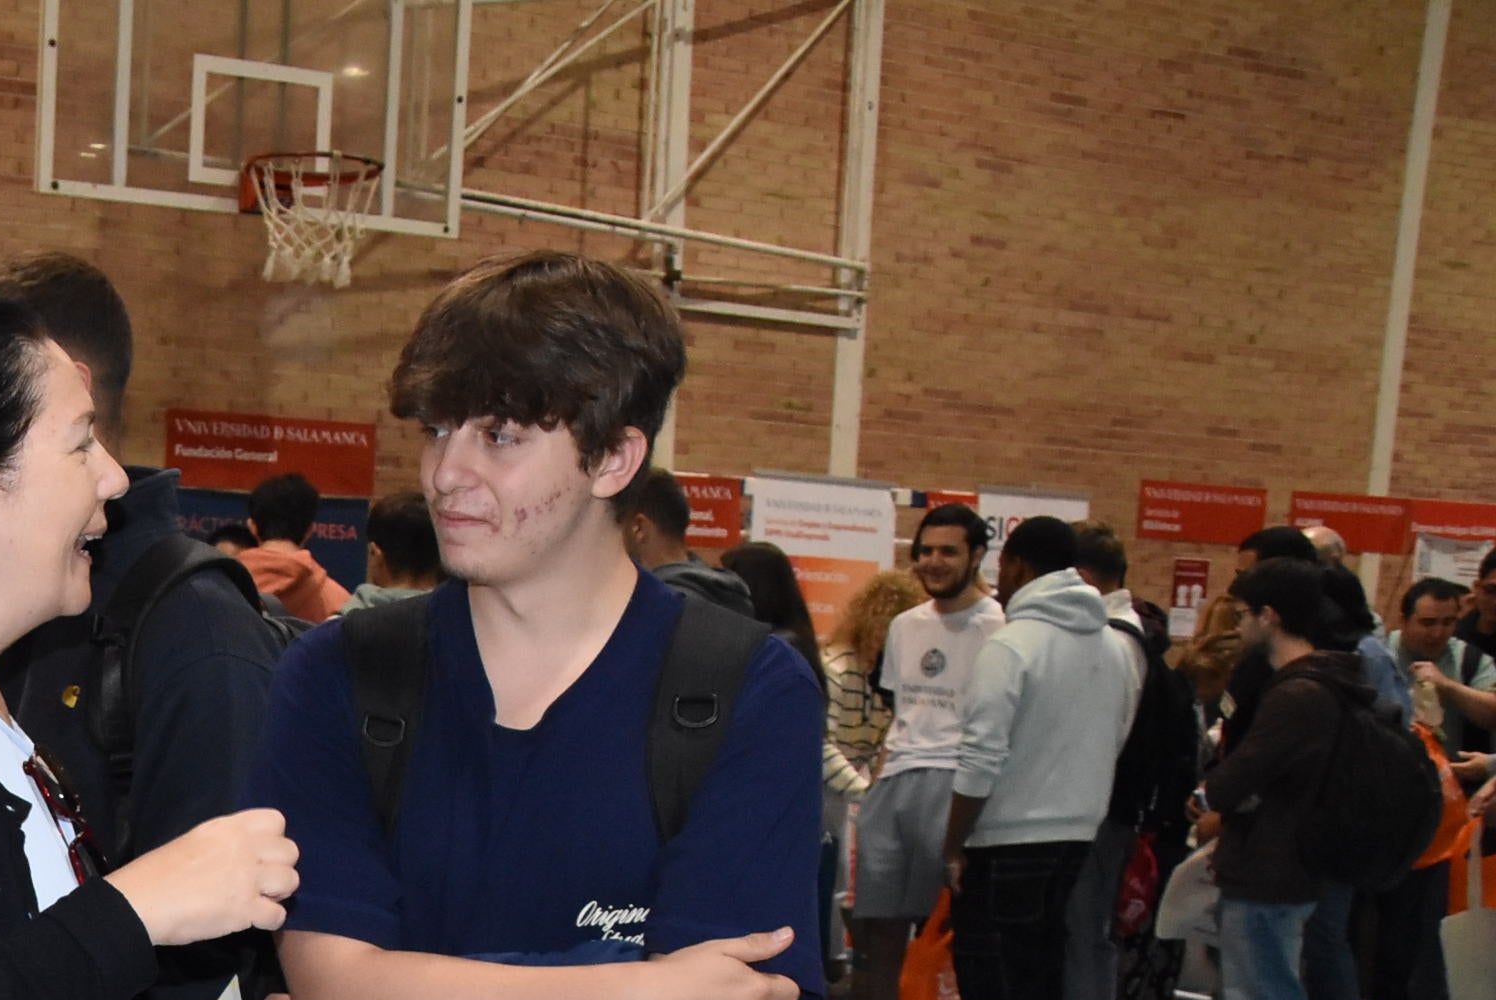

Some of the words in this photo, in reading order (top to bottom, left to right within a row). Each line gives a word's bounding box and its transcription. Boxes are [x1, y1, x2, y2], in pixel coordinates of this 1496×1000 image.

[286, 429, 368, 448] SALAMANCA
[175, 444, 233, 459] Fundación
[235, 448, 278, 462] General
